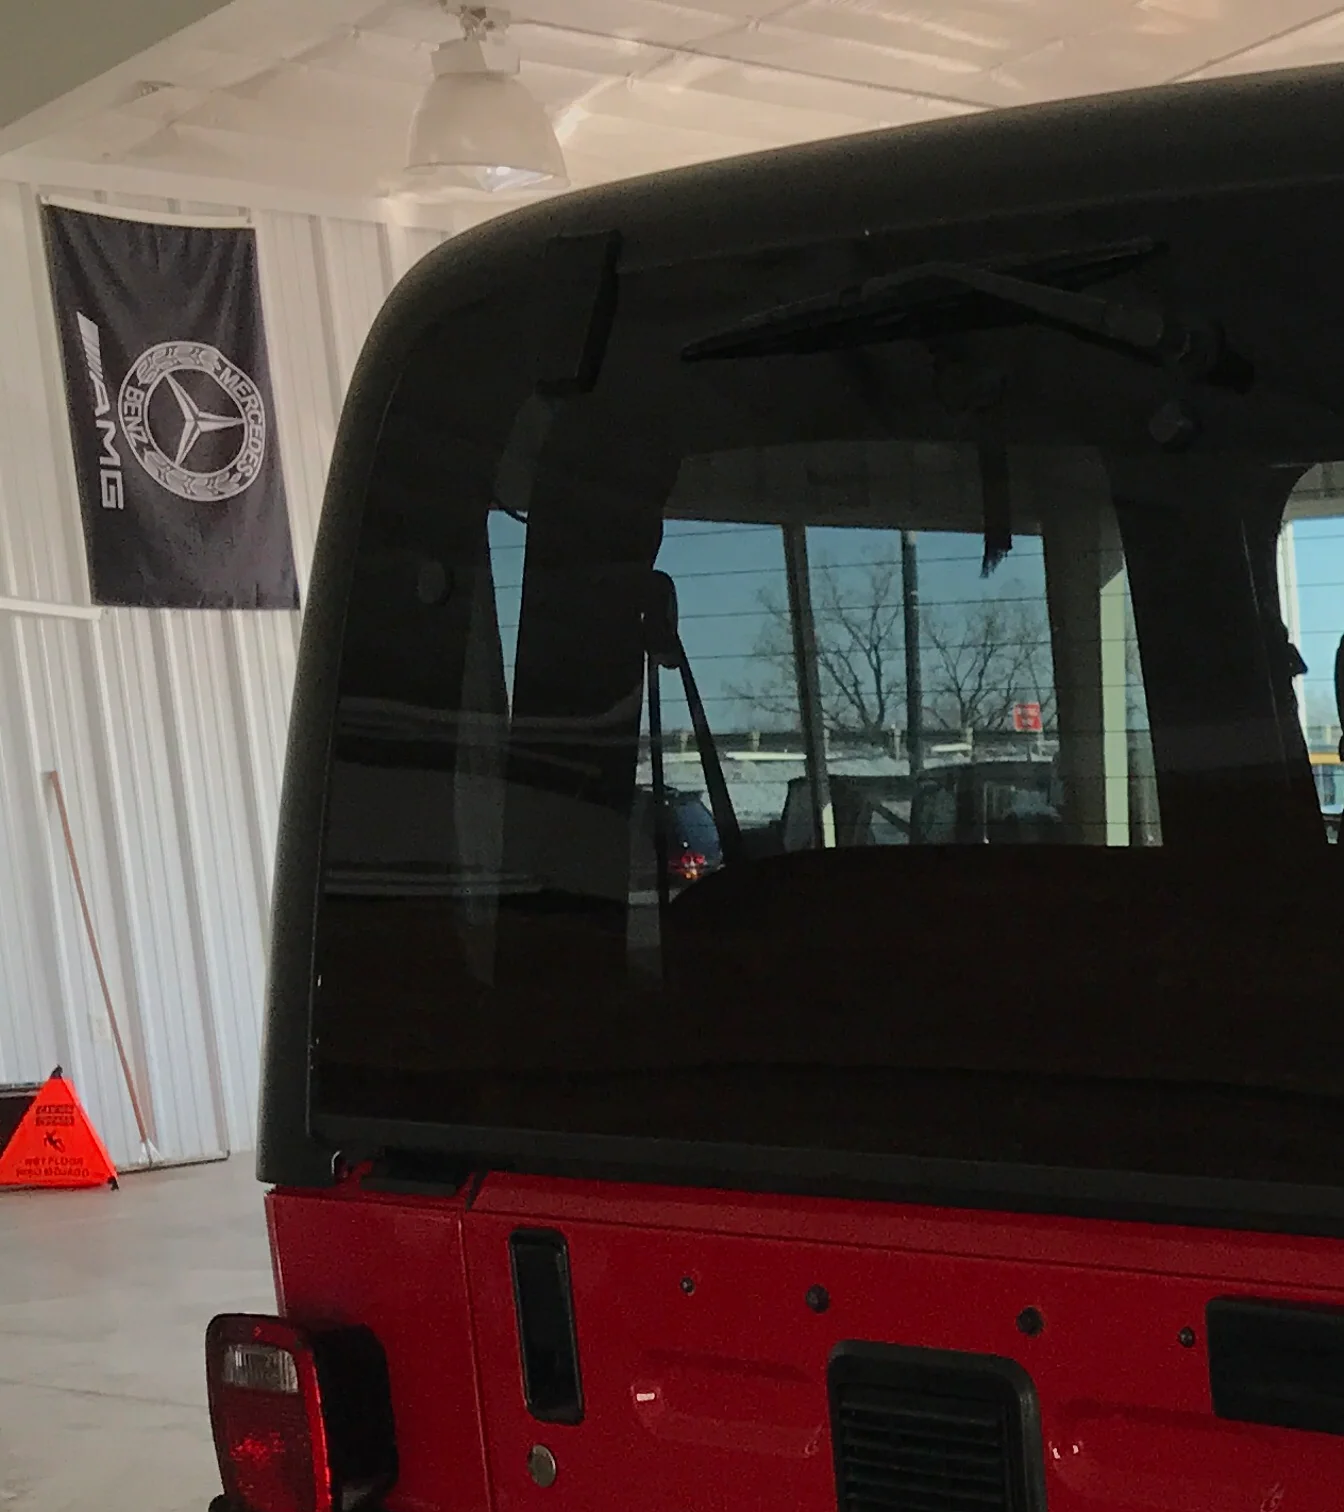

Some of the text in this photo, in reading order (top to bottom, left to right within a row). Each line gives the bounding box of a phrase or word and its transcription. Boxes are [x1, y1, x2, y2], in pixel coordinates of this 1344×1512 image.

[94, 377, 124, 511] AMG
[123, 386, 149, 446] BENZ
[218, 367, 263, 478] MERCEDES
